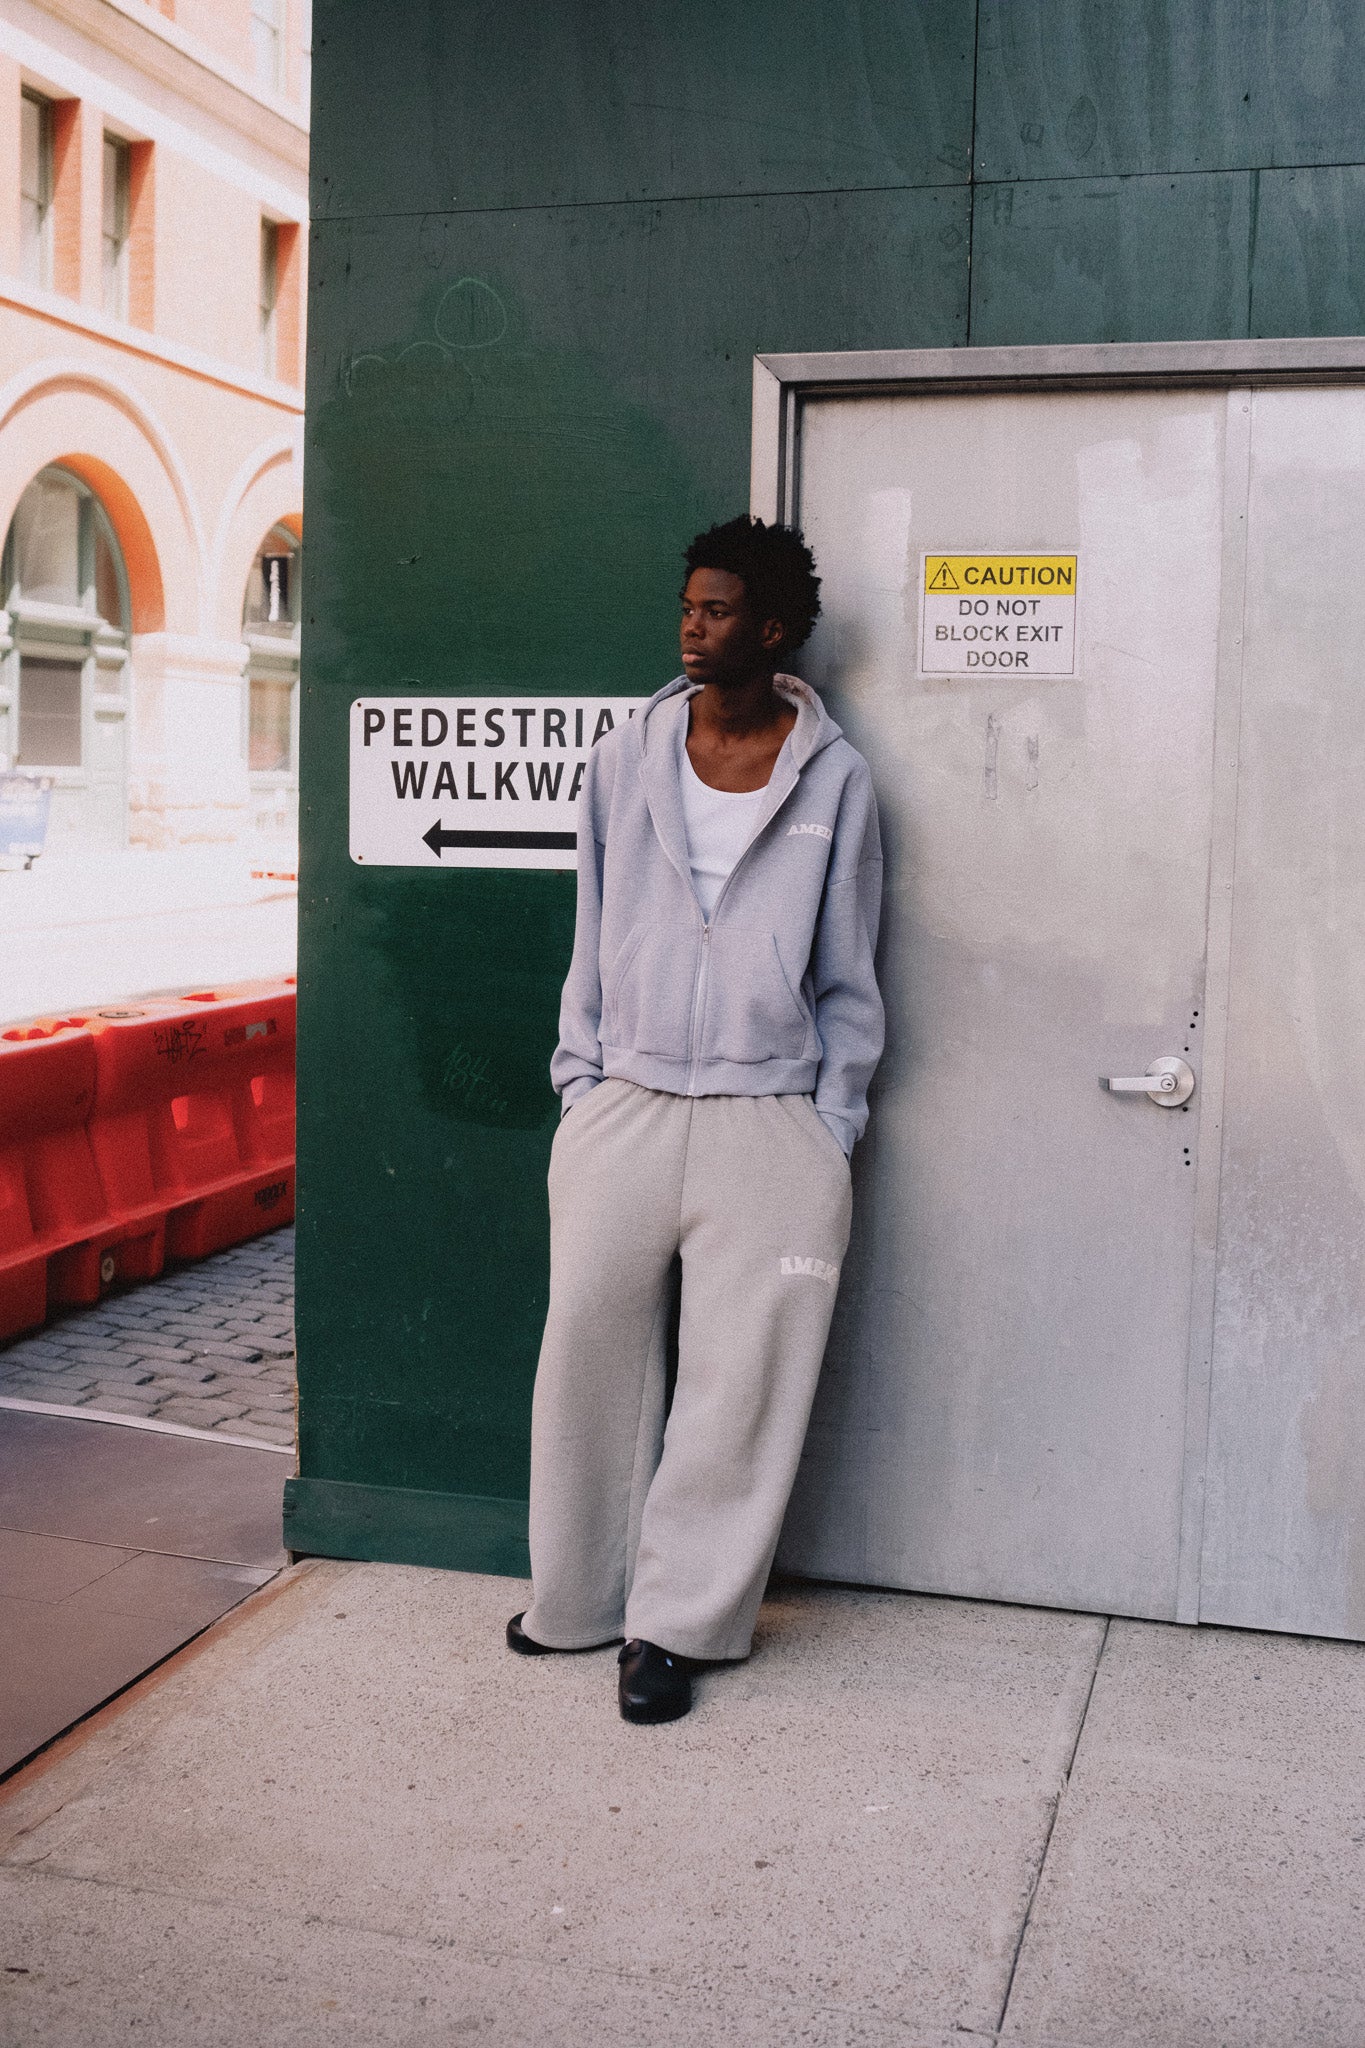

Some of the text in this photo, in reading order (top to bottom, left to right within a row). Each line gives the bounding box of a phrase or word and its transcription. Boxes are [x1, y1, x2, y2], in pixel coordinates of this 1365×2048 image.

[964, 567, 1072, 585] CAUTION
[959, 600, 1041, 616] DO NOT
[935, 625, 1063, 642] BLOCK EXIT
[966, 651, 1029, 668] DOOR
[363, 708, 637, 748] PEDESTRIA
